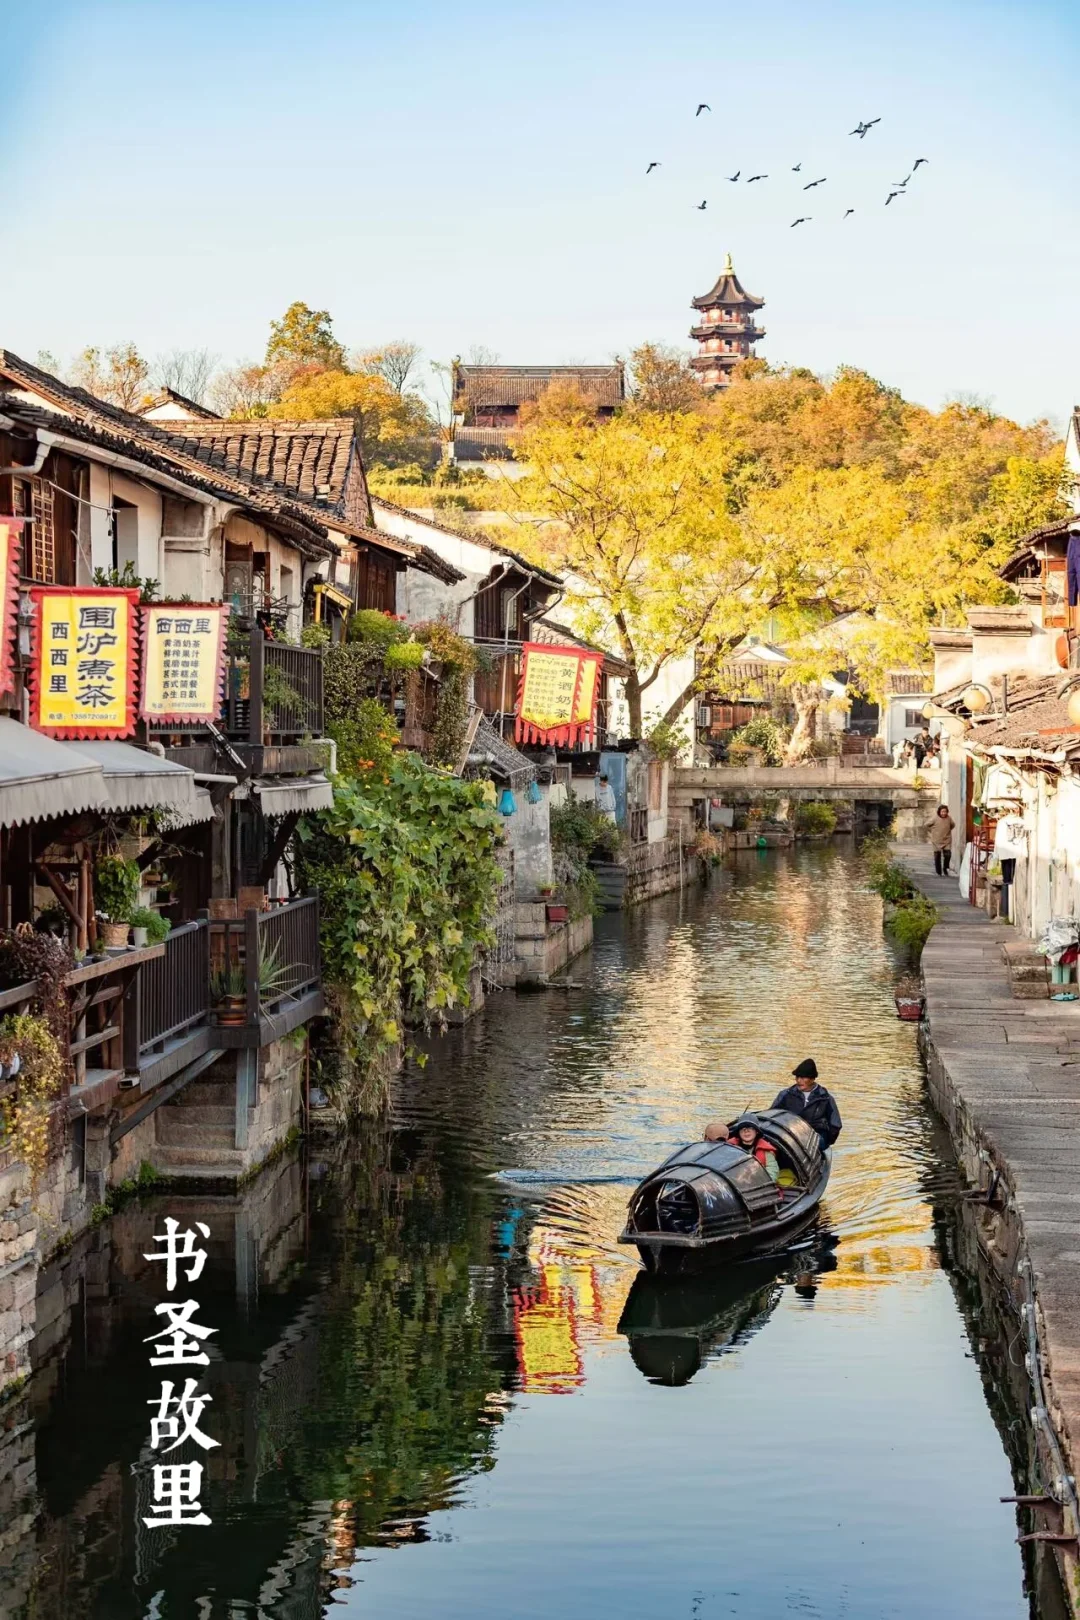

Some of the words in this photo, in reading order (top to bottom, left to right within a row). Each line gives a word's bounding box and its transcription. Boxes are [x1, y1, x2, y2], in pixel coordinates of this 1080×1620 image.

[156, 617, 211, 635] 西西里
[163, 638, 200, 648] 黄酒奶茶
[49, 621, 70, 693] 西西里
[76, 606, 118, 709] 围炉煮茶
[163, 649, 200, 658] 鲜榨果汁
[554, 667, 575, 719] 黄酒奶茶
